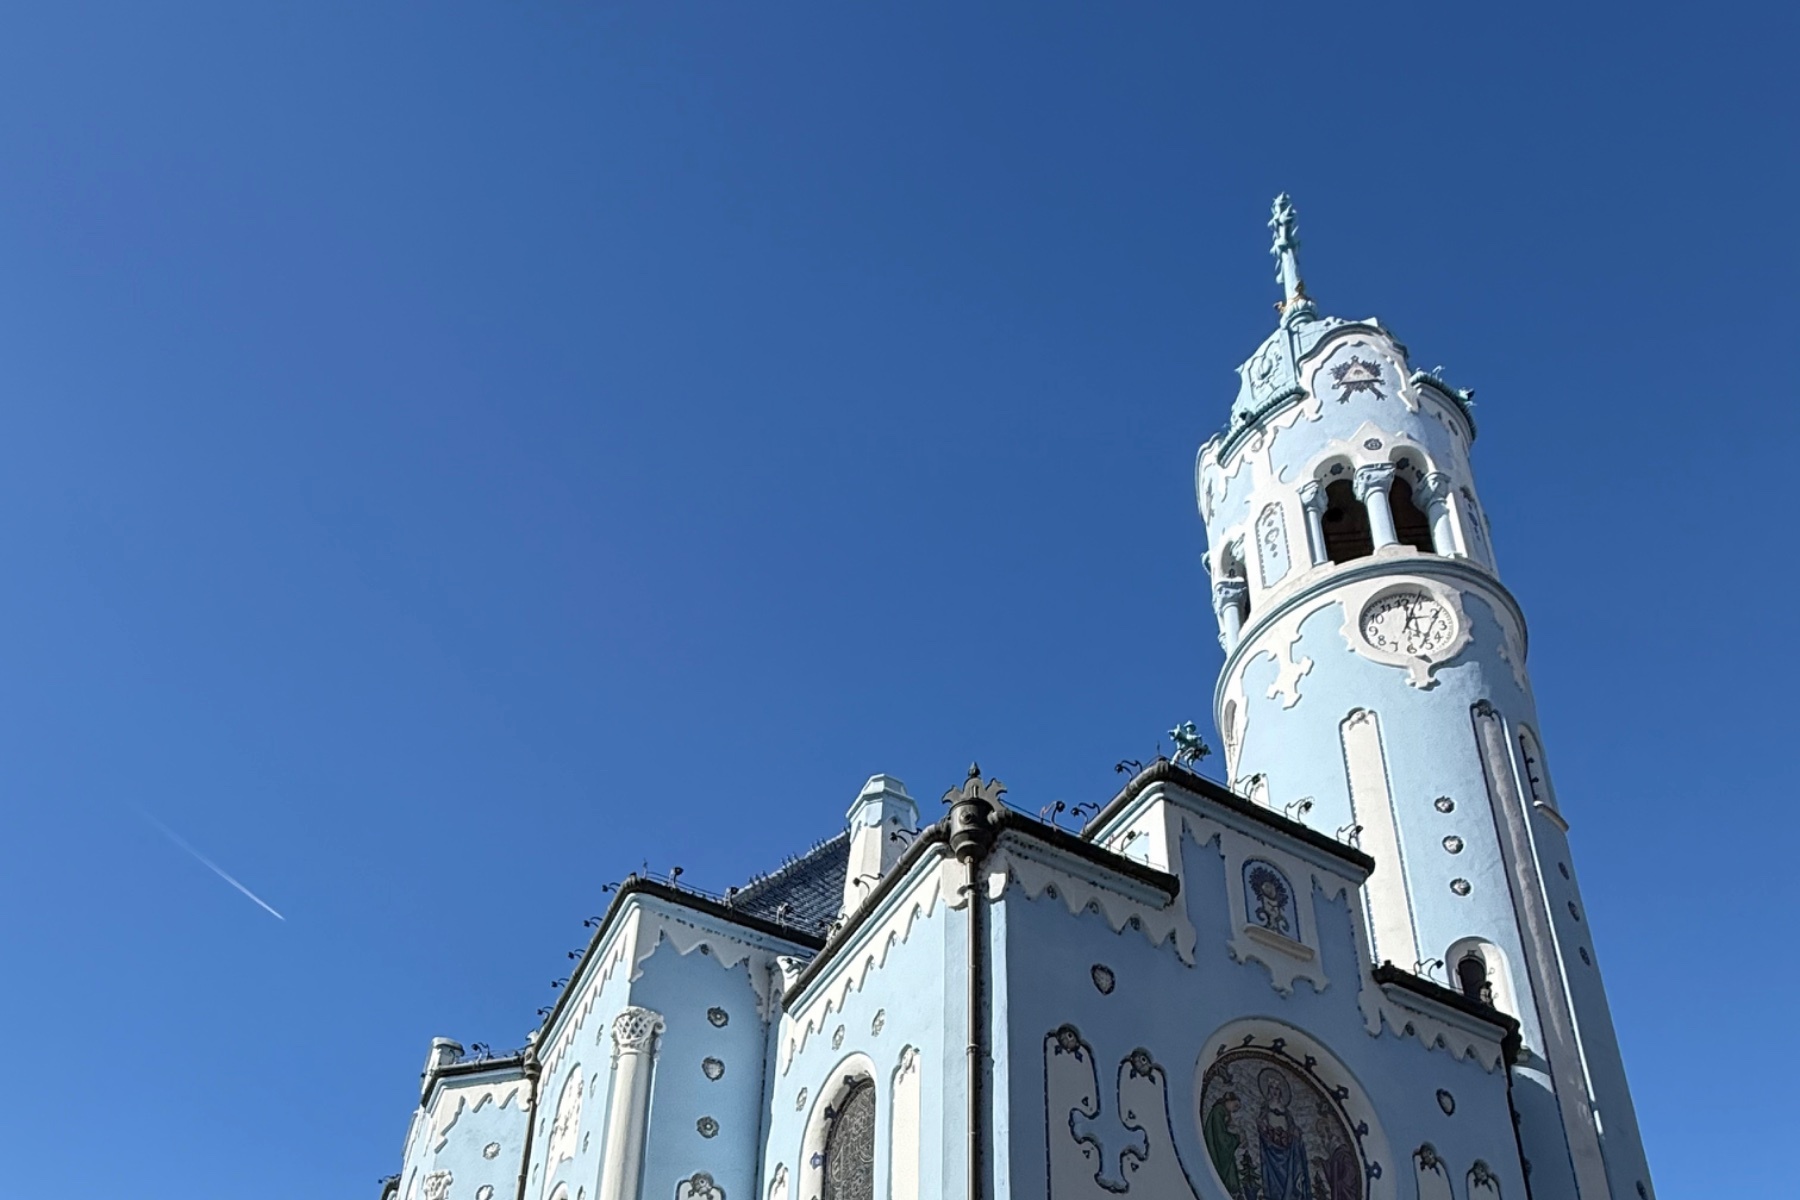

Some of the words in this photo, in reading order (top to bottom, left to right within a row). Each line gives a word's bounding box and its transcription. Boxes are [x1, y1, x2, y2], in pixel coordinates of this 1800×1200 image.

[1380, 604, 1392, 612] 11
[1394, 599, 1409, 611] 12
[1370, 613, 1384, 624] 10
[1369, 626, 1379, 636] 9
[1438, 620, 1447, 631] 3
[1377, 635, 1387, 646] 8
[1434, 631, 1443, 643] 4
[1389, 642, 1398, 652] 7
[1406, 644, 1417, 654] 6
